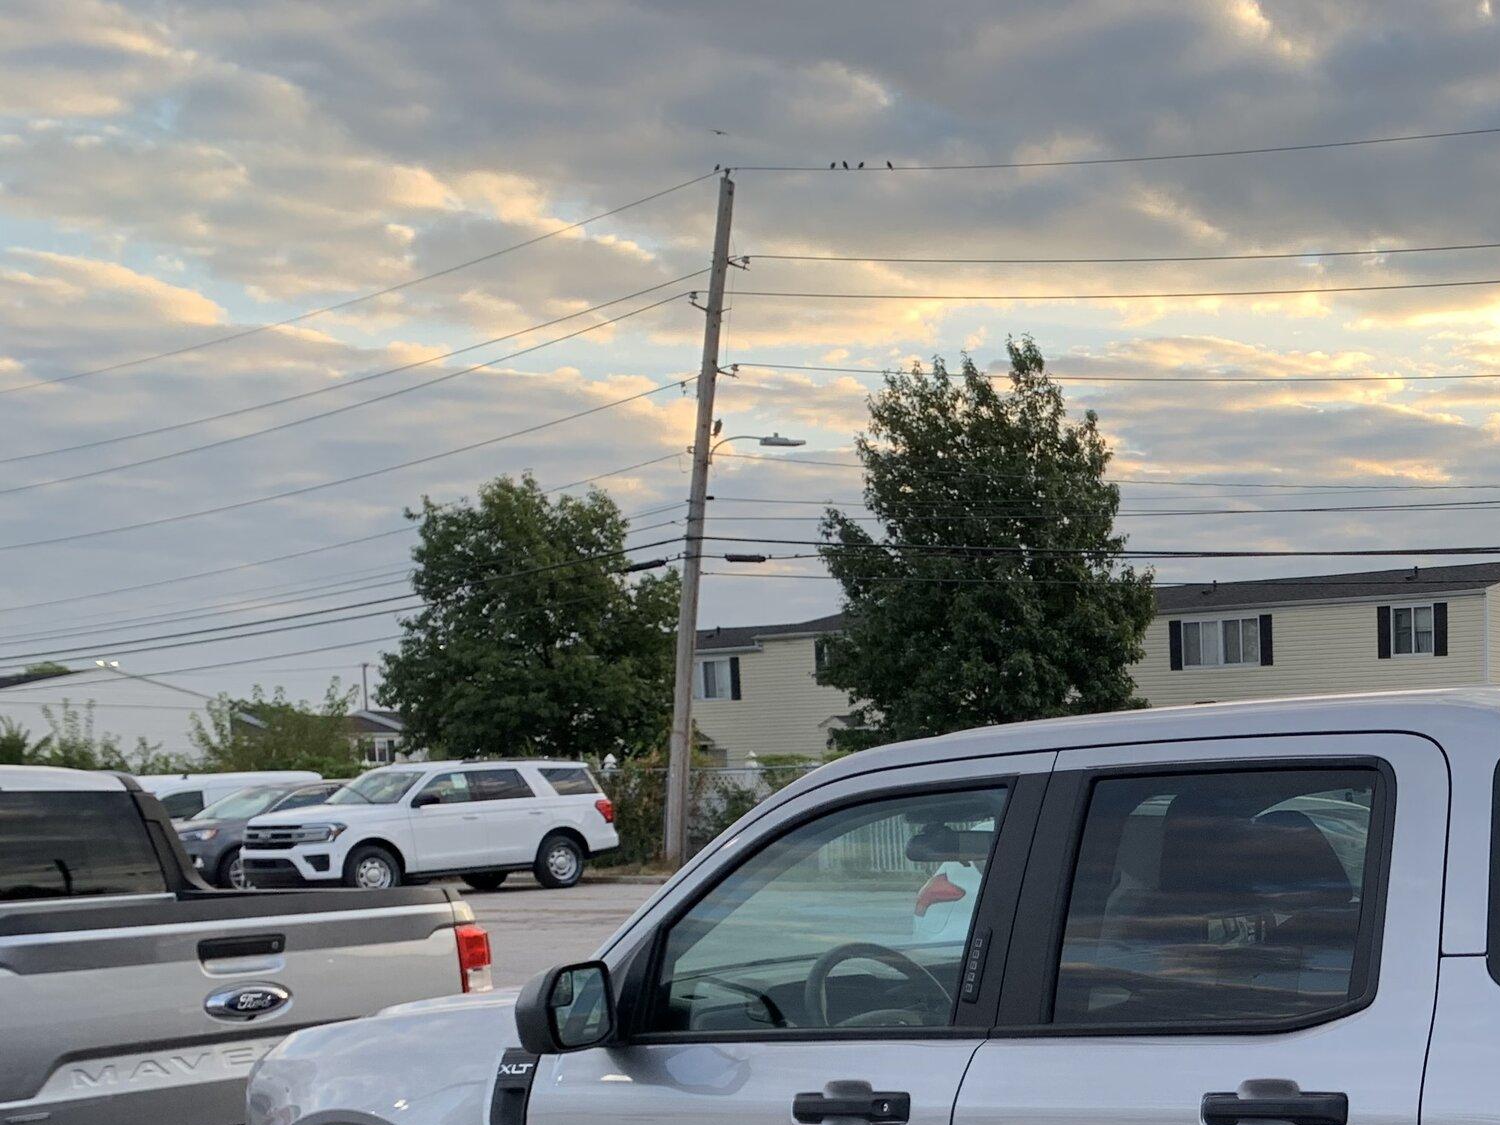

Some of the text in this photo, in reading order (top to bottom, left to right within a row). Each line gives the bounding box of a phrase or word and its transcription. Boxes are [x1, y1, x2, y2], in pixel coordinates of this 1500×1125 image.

[237, 993, 272, 1010] Ford
[70, 1044, 276, 1091] MAVE
[498, 1063, 533, 1075] XLT
